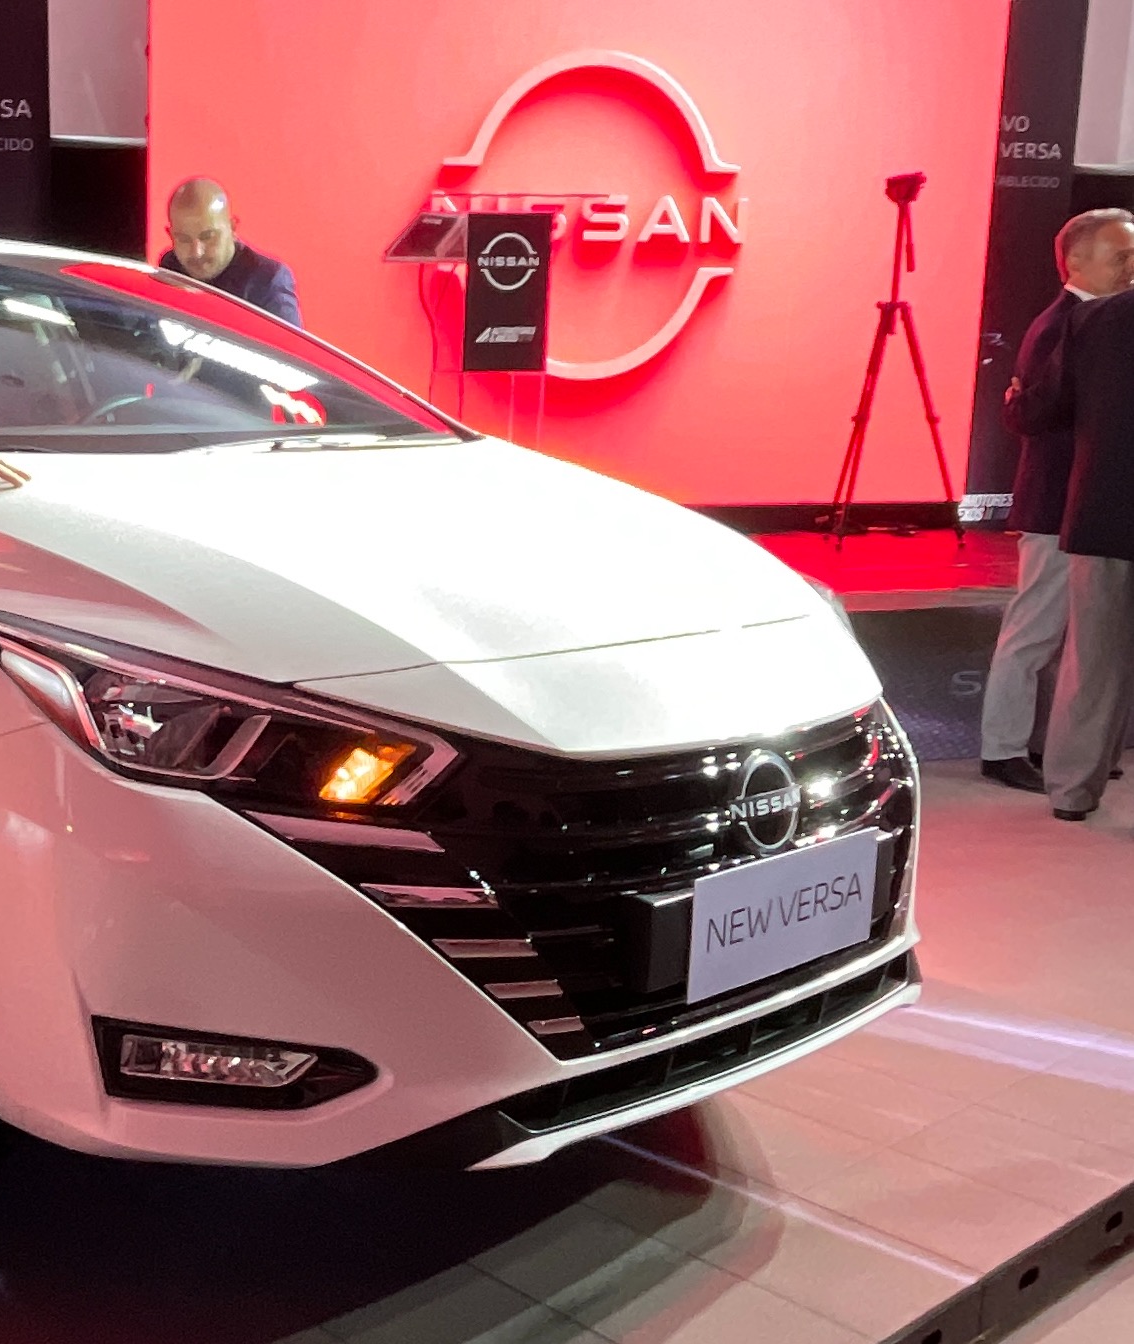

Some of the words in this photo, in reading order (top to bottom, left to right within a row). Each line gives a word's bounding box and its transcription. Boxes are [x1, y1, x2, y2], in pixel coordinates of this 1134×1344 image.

[999, 142, 1062, 160] VERSA
[477, 256, 540, 267] NISSAN
[729, 788, 801, 820] NISSAN
[706, 898, 773, 954] NEW
[778, 872, 862, 927] VERSA
